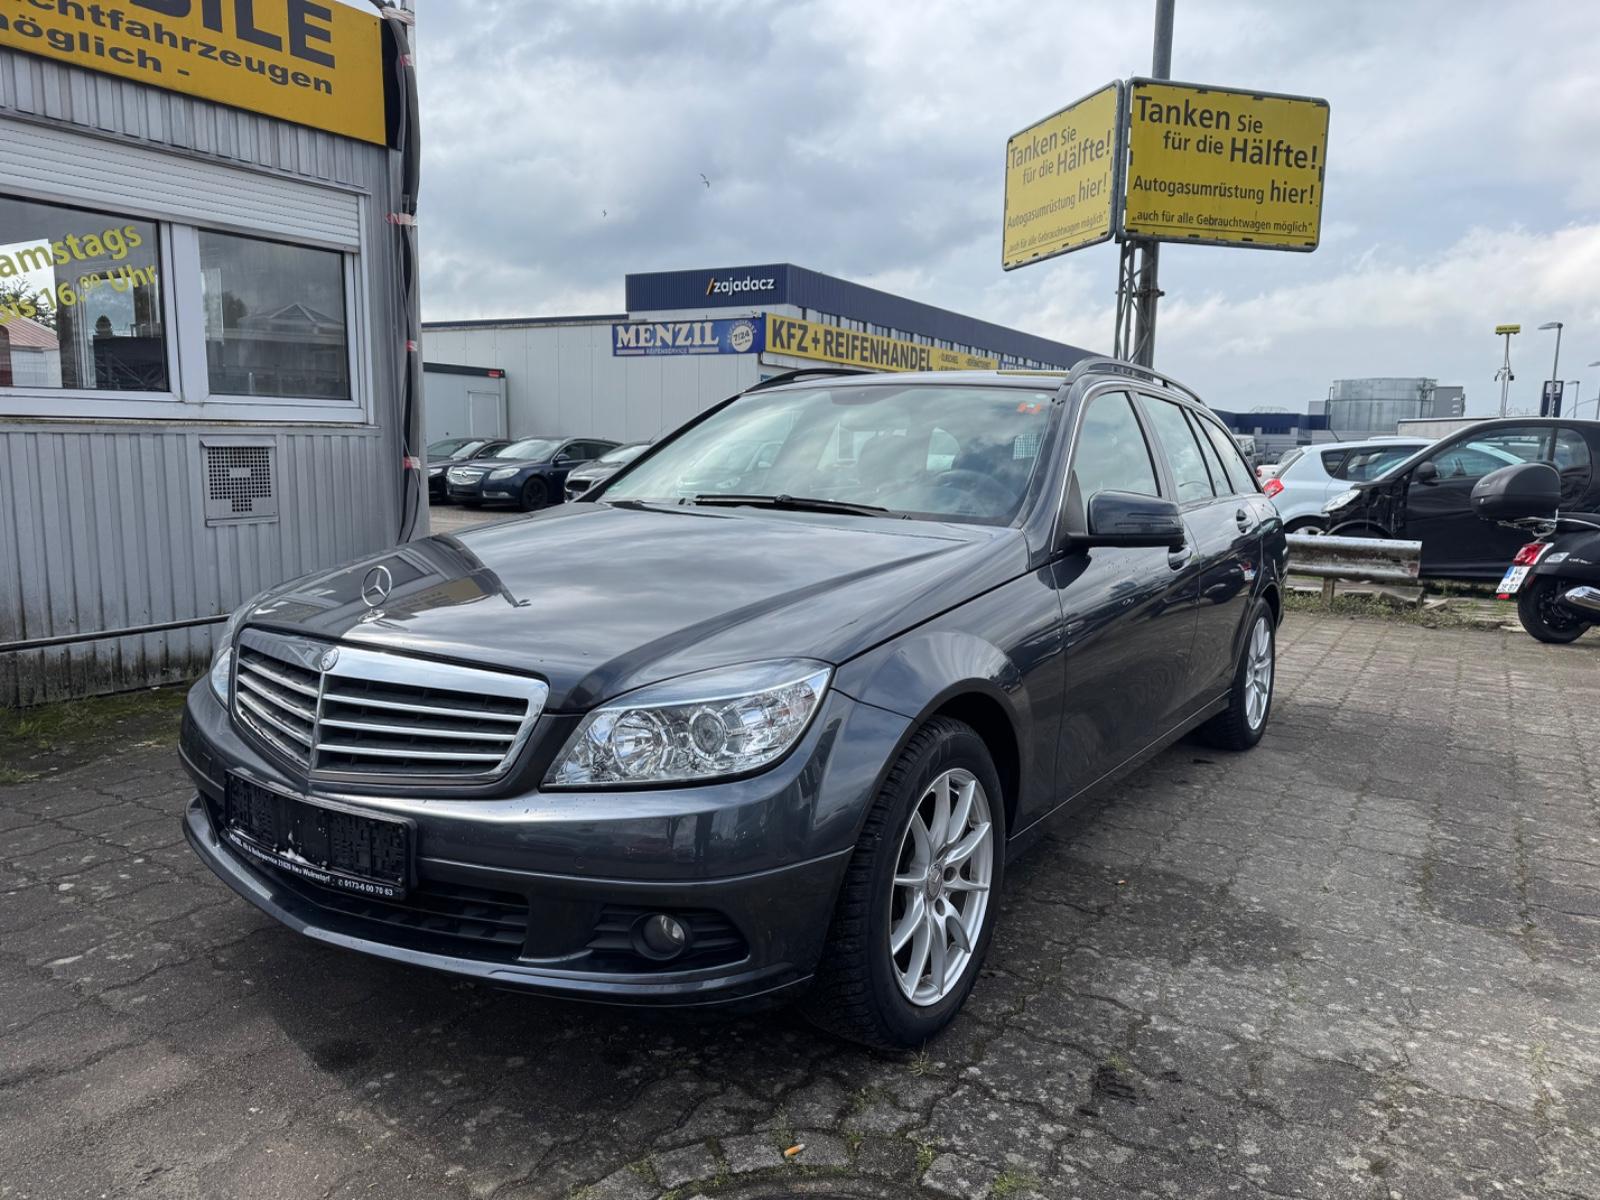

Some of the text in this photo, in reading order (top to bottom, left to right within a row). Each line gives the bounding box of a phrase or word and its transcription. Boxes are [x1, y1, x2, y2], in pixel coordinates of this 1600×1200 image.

[15, 0, 333, 95] chtfahrzeugen
[1135, 94, 1264, 134] Tanken Sie
[1010, 125, 1077, 169] Tanken Sie
[1023, 129, 1111, 185] für die Hälfte!
[1163, 130, 1318, 170] für die Hälfte!
[1007, 172, 1107, 230] Autogasumrüstung hier!
[1132, 175, 1315, 205] Autogasumrüstung hier!
[1161, 211, 1175, 223] für
[1177, 213, 1194, 225] alle
[1196, 214, 1272, 233] Gebrauchtwagen
[106, 263, 156, 293] Uhr
[615, 321, 719, 348] MENZIL
[771, 318, 809, 353] KFZ
[823, 329, 933, 371] REIFENHANDEL
